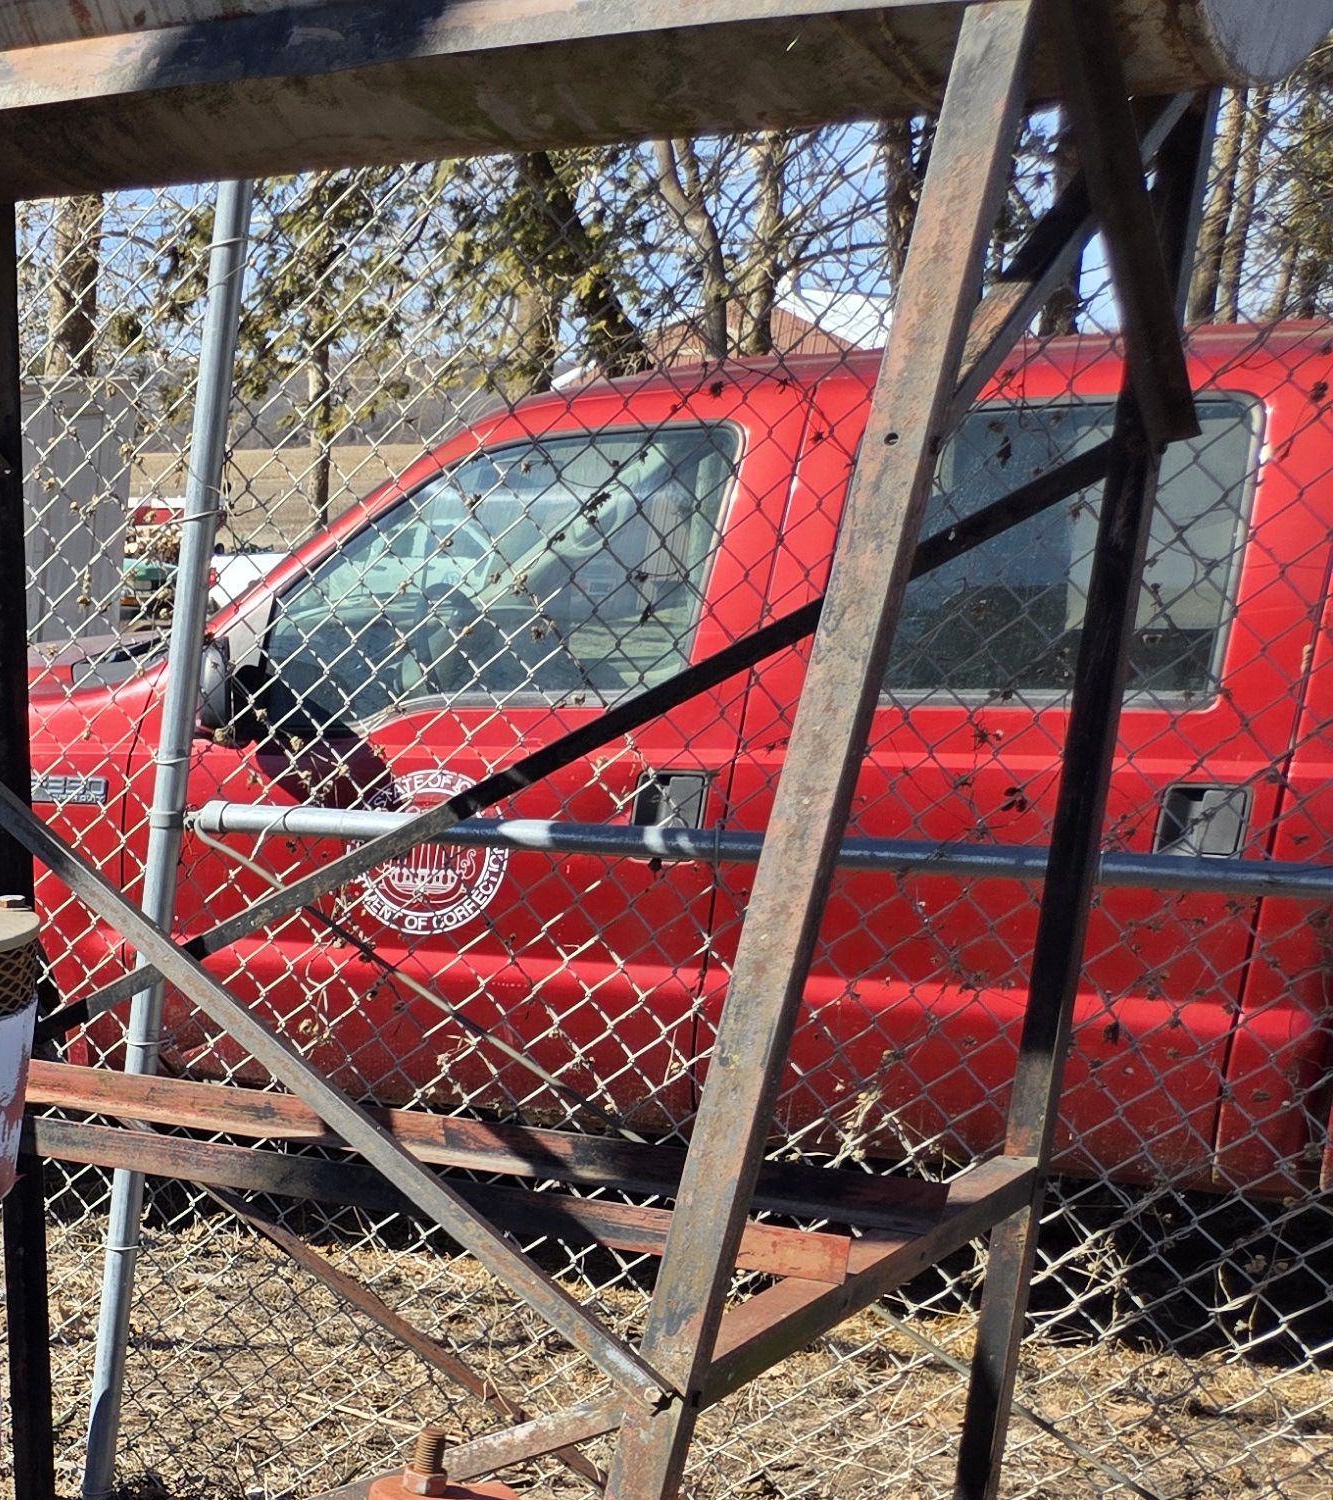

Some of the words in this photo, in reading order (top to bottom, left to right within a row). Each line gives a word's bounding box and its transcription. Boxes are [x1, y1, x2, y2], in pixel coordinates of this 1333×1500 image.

[428, 774, 453, 788] OF
[404, 916, 429, 931] OF
[433, 848, 505, 929] CORRECTIO
